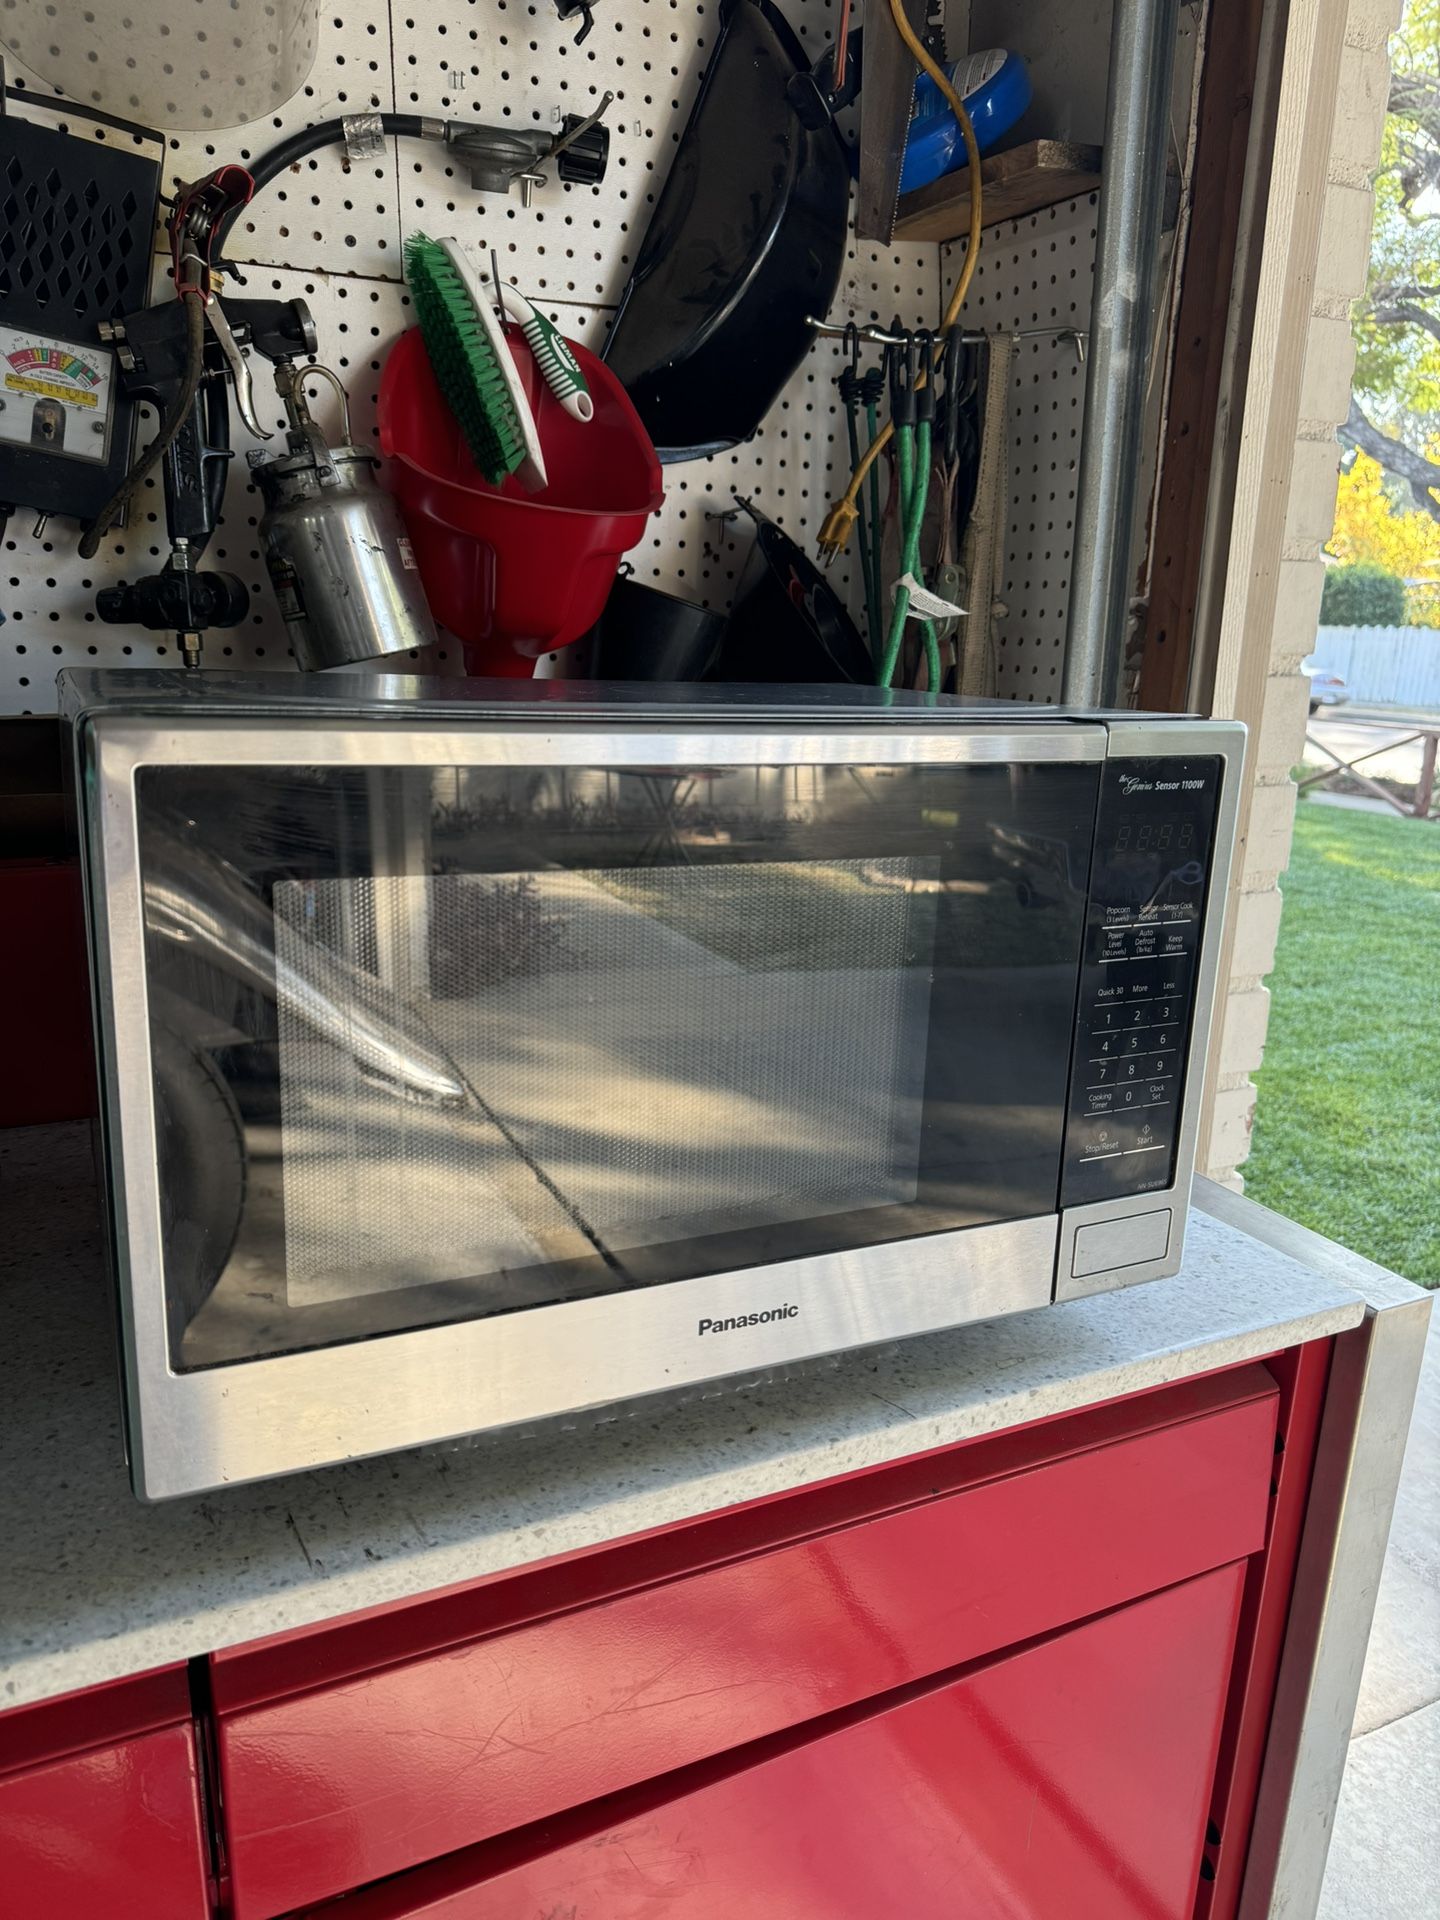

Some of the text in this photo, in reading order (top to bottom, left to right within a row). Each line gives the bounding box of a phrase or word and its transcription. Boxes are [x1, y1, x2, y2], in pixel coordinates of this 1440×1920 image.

[1122, 777, 1153, 795] Genius
[1155, 780, 1180, 791] Sensor
[1181, 779, 1205, 790] 1100W
[1106, 906, 1131, 915] Popcorn
[1163, 902, 1193, 911] Sensor Cook
[1107, 931, 1125, 940] Power
[1138, 929, 1154, 937] Auto
[1134, 937, 1156, 946] Defrost
[1168, 935, 1183, 943] Keep
[1108, 941, 1122, 949] Level
[1165, 943, 1183, 952] Warm
[1132, 984, 1148, 993] More
[1163, 982, 1175, 990] Less
[1097, 986, 1124, 997] Quick 30
[1134, 1010, 1141, 1021] 2
[1162, 1007, 1169, 1018] 3
[1106, 1013, 1111, 1024] 1
[1131, 1037, 1138, 1048] 5
[1159, 1033, 1166, 1044] 6
[1101, 1041, 1109, 1052] 4
[1128, 1064, 1135, 1075] 8
[1156, 1060, 1163, 1071] 9
[1099, 1068, 1106, 1079] 7
[1149, 1083, 1165, 1093] Clock
[1088, 1092, 1112, 1102] Cooking
[1125, 1091, 1132, 1102] 0
[1151, 1093, 1161, 1101] Set
[1091, 1102, 1108, 1110] Timer
[1136, 1136, 1153, 1146] Start
[1084, 1141, 1119, 1154] Stop/Reset
[698, 1303, 799, 1336] Panasonic
